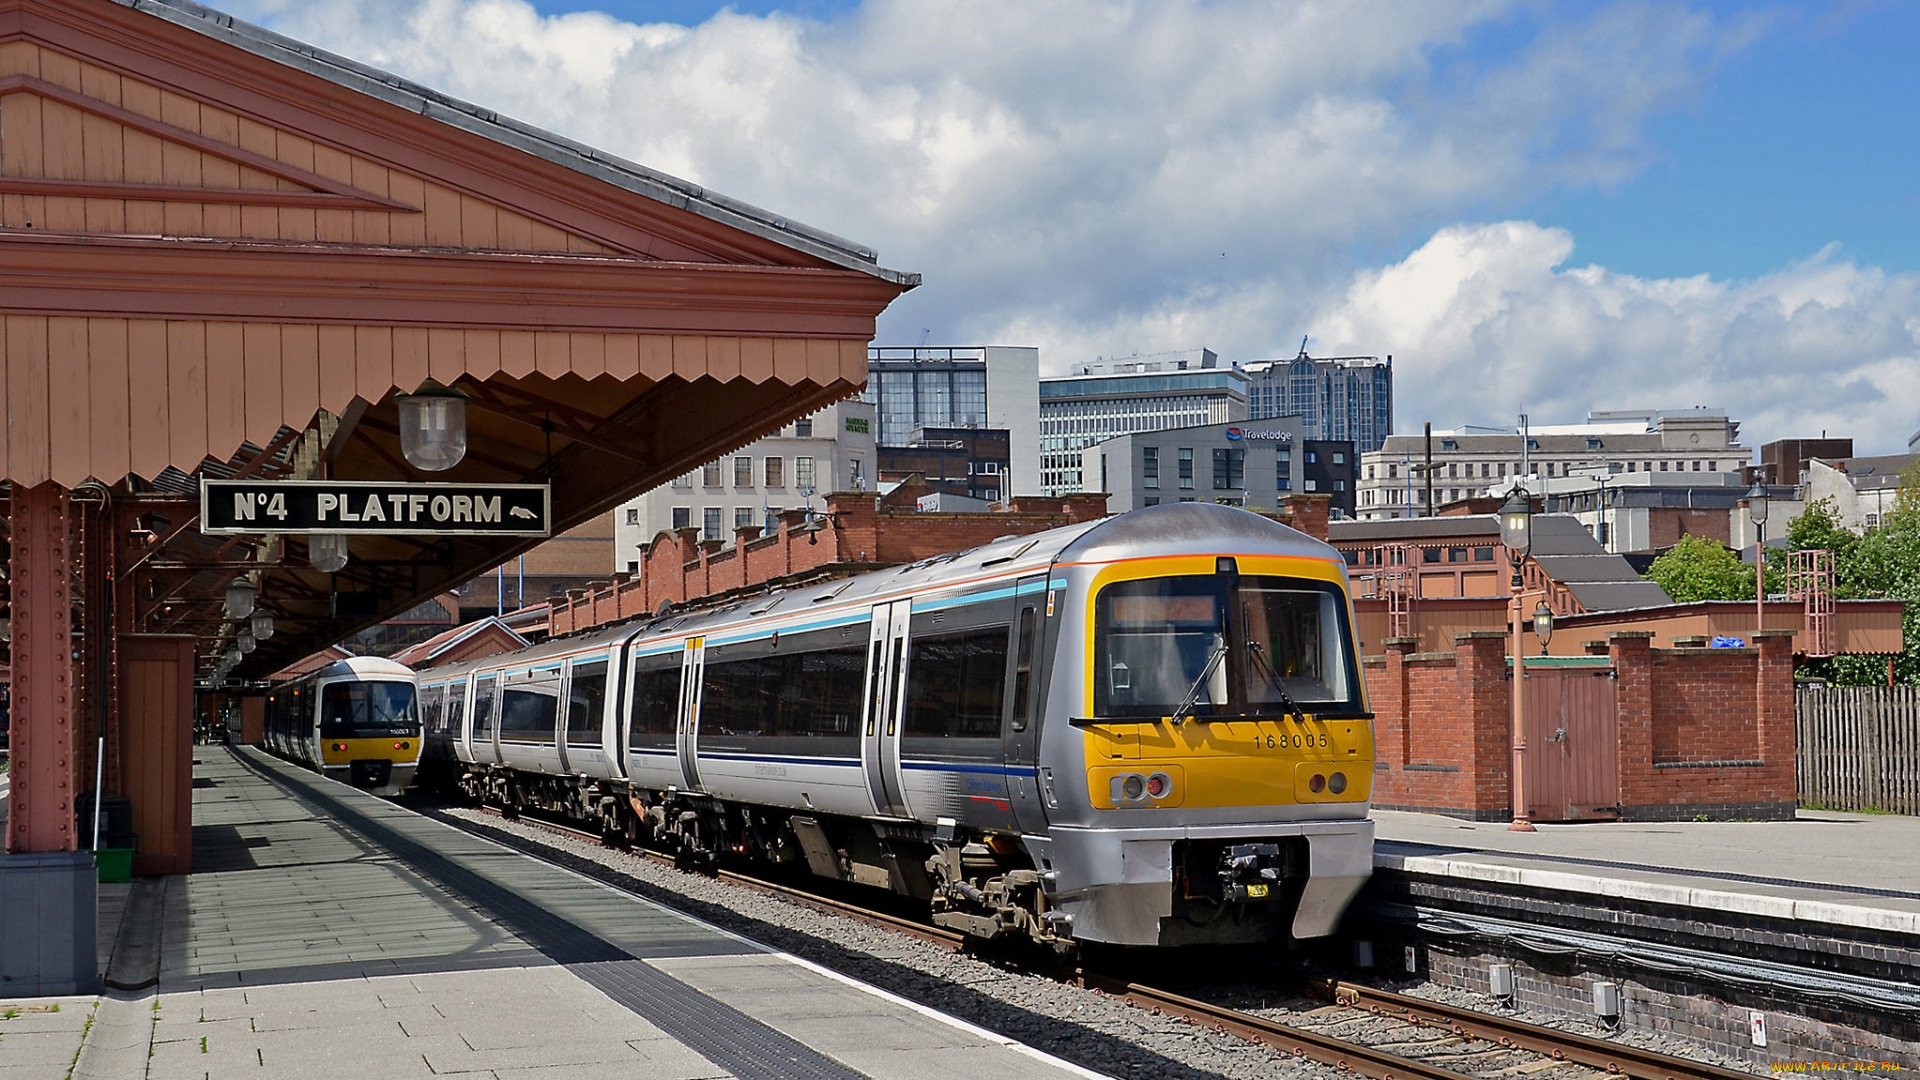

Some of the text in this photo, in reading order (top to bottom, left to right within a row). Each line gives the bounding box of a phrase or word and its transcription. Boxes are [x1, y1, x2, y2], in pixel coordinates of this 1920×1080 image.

[1242, 428, 1292, 442] Travelodge
[317, 493, 502, 523] PLATFORM
[1254, 733, 1328, 749] 168005
